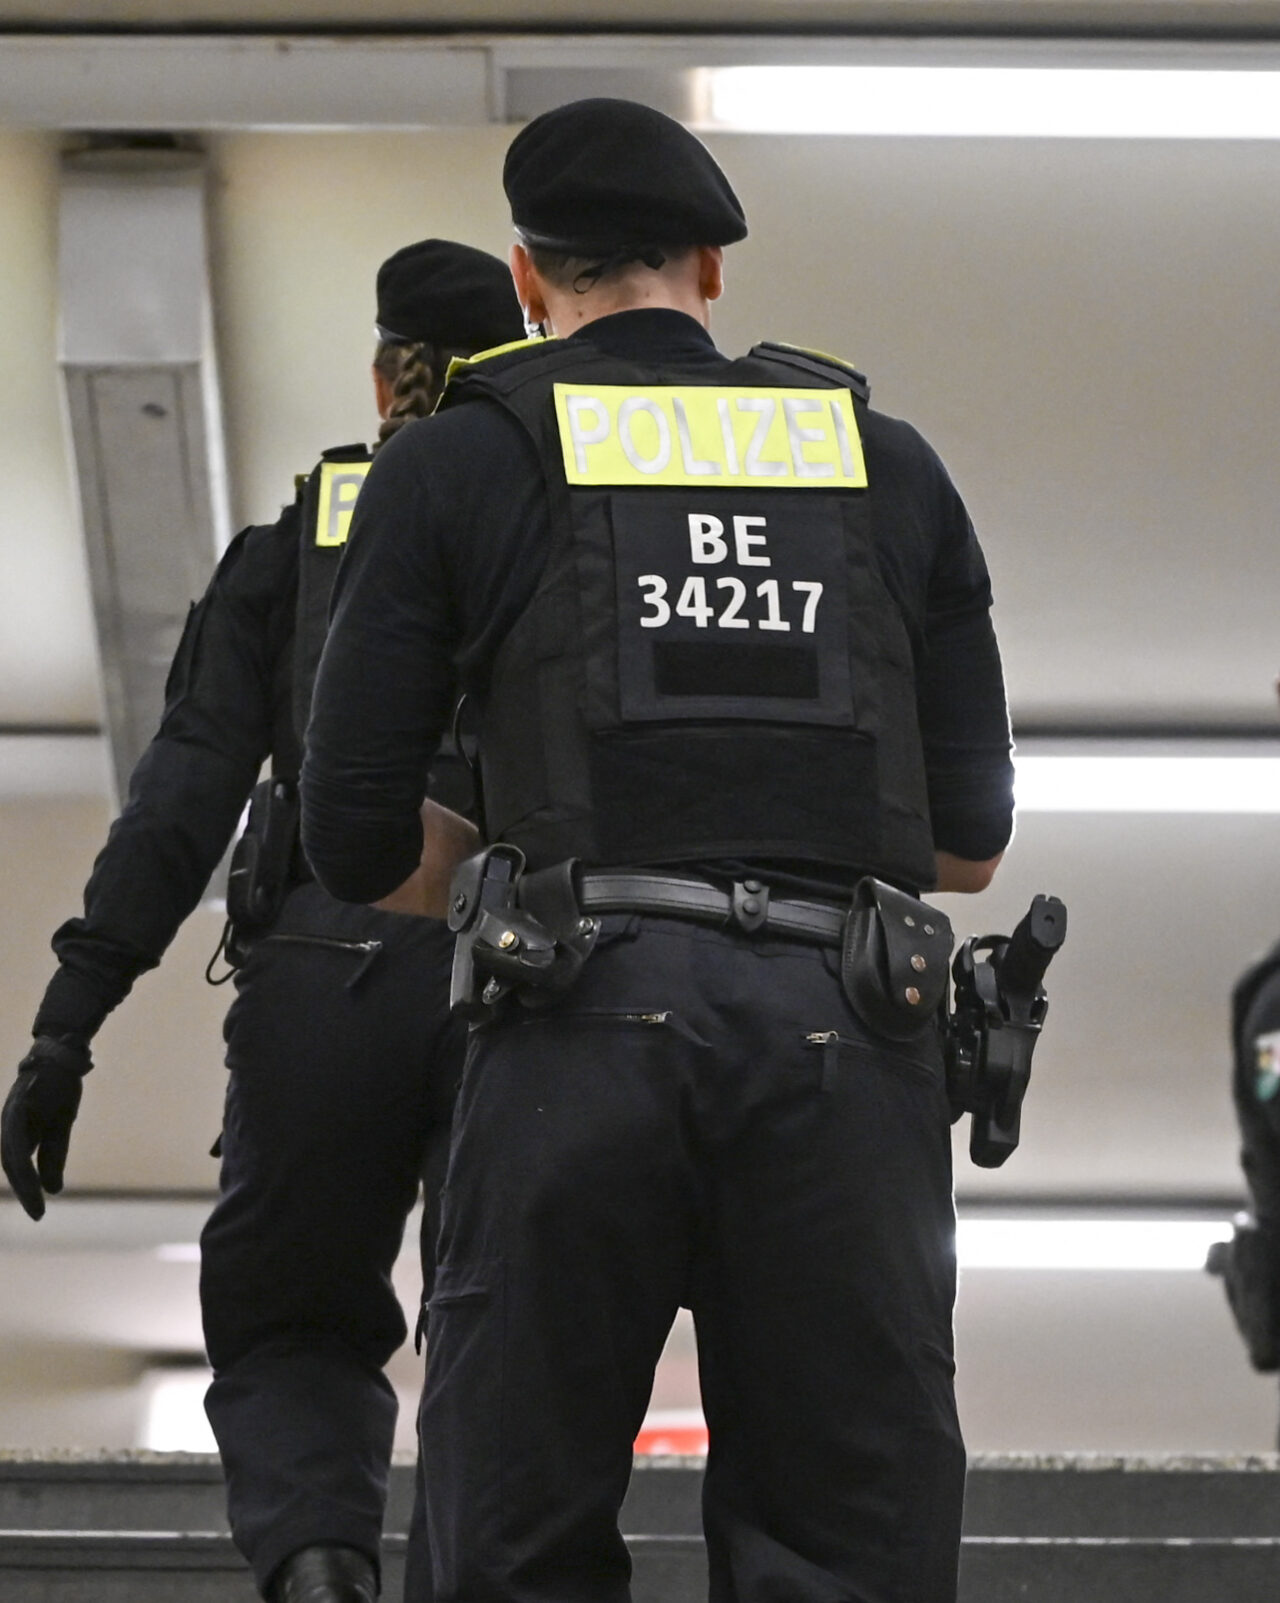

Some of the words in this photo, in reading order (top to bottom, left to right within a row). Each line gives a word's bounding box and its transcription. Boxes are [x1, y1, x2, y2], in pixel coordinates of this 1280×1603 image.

[565, 394, 855, 478] POLIZEI
[688, 513, 771, 567] BE
[637, 574, 823, 633] 34217
